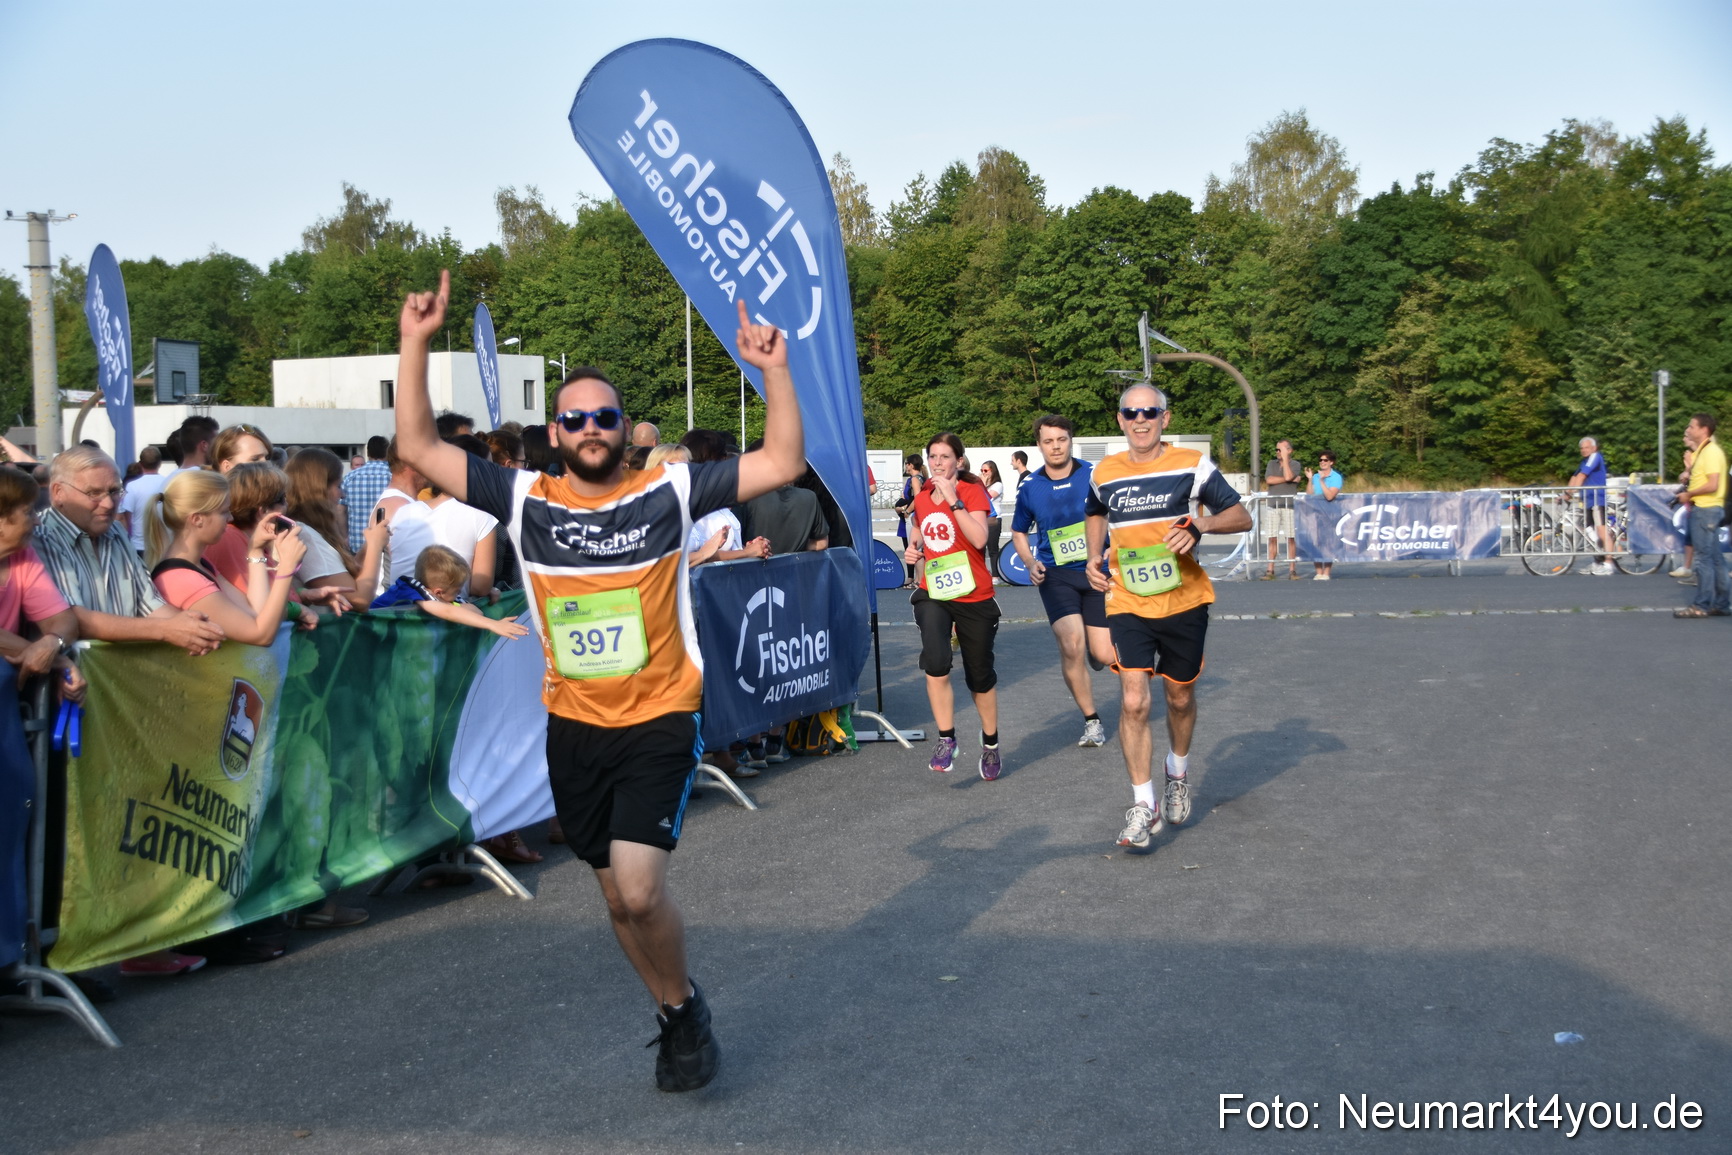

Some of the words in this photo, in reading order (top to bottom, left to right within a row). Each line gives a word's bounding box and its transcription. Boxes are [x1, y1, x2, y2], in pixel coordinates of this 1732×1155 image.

[1118, 493, 1171, 507] Fischer
[1122, 503, 1168, 513] AUTOMOBILE
[924, 522, 950, 540] 48
[1357, 520, 1458, 540] Fischer
[578, 540, 646, 555] AUTOMOBILE
[1060, 538, 1086, 554] 803
[1366, 541, 1450, 551] AUTOMOBILE
[935, 571, 963, 589] 539
[1127, 563, 1173, 583] 1519
[569, 625, 623, 656] 397
[763, 669, 830, 704] AUTOMOBILE
